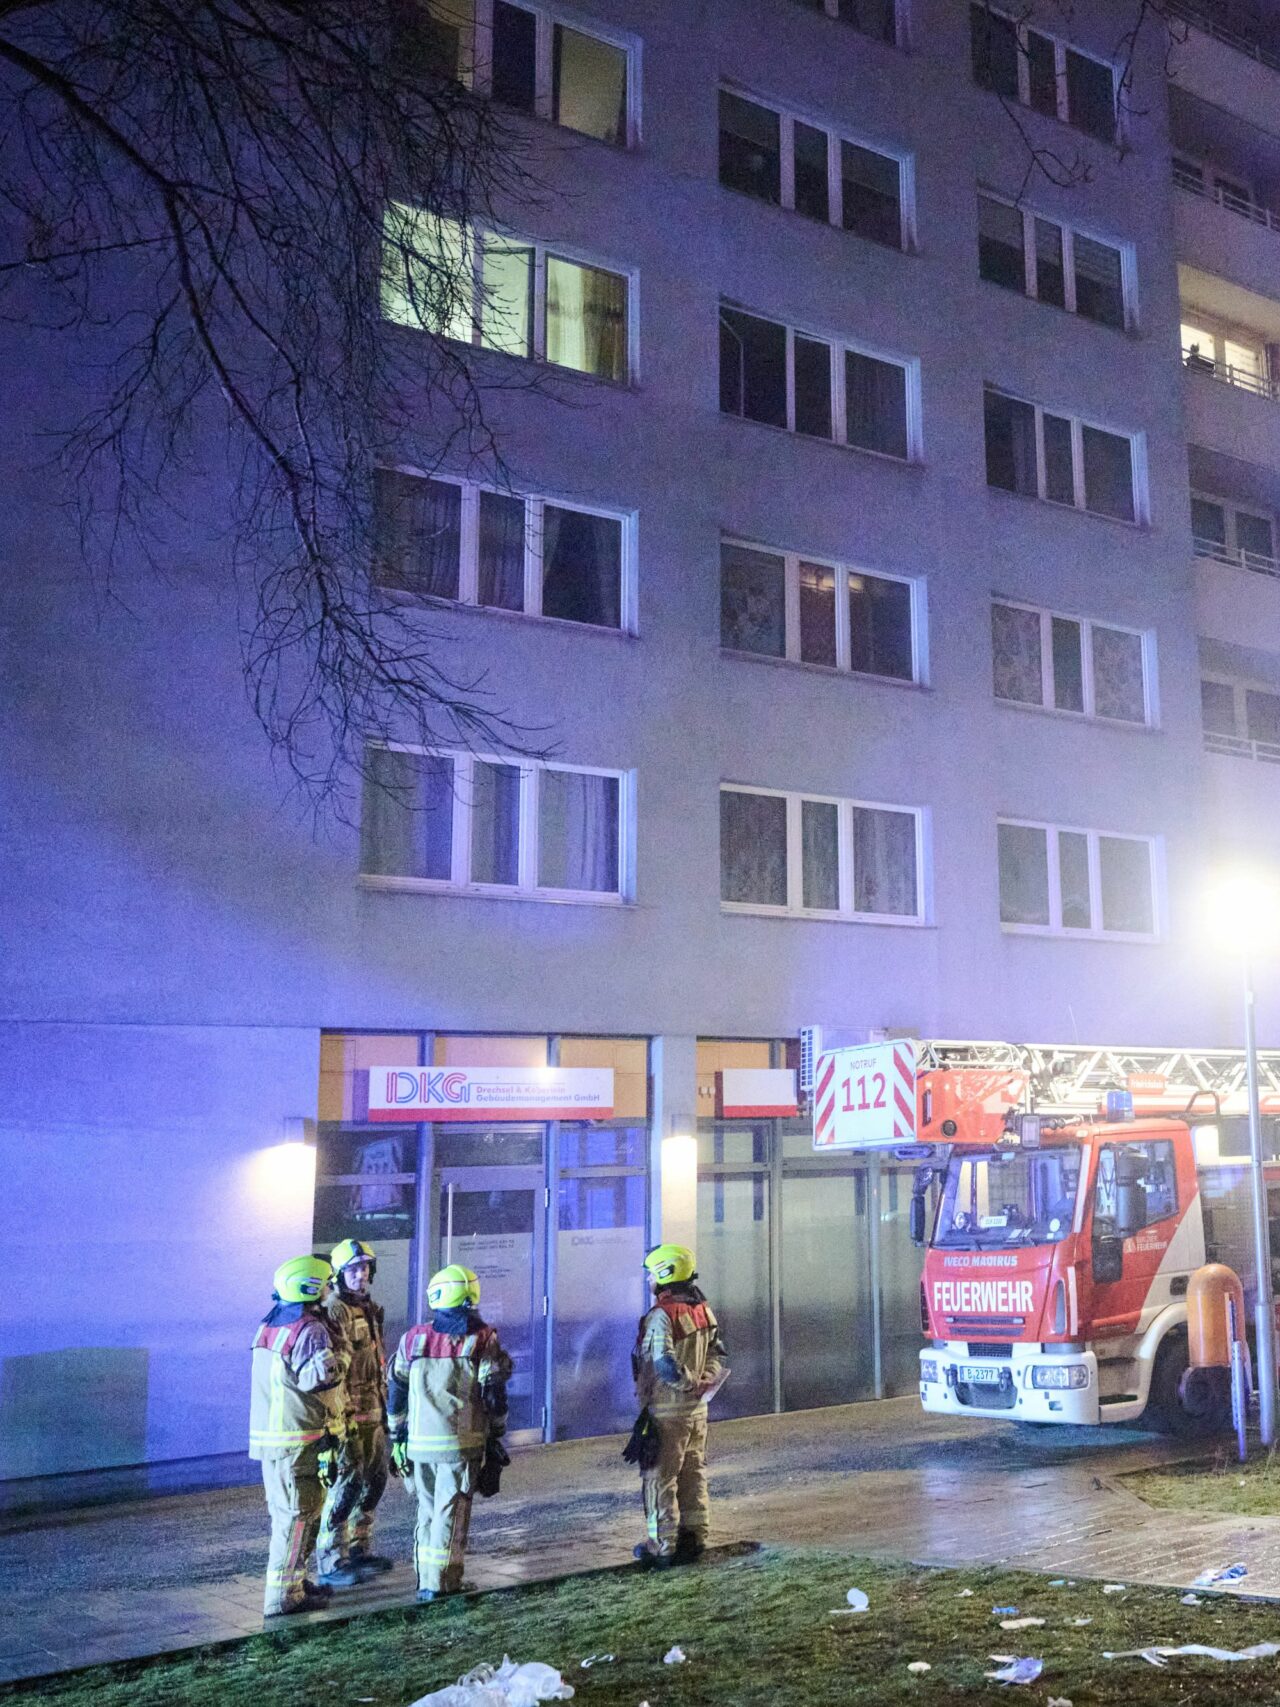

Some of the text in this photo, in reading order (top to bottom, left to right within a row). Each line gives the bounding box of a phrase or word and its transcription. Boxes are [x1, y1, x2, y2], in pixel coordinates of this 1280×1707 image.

[850, 1058, 877, 1070] NOTRUF
[386, 1072, 471, 1104] DKG
[841, 1072, 887, 1112] 112
[574, 1094, 600, 1102] GmbH
[944, 1255, 1018, 1267] IVECO MAGIRUS
[933, 1280, 1035, 1313] FEUERWEHR
[967, 1368, 994, 1380] B 2377
